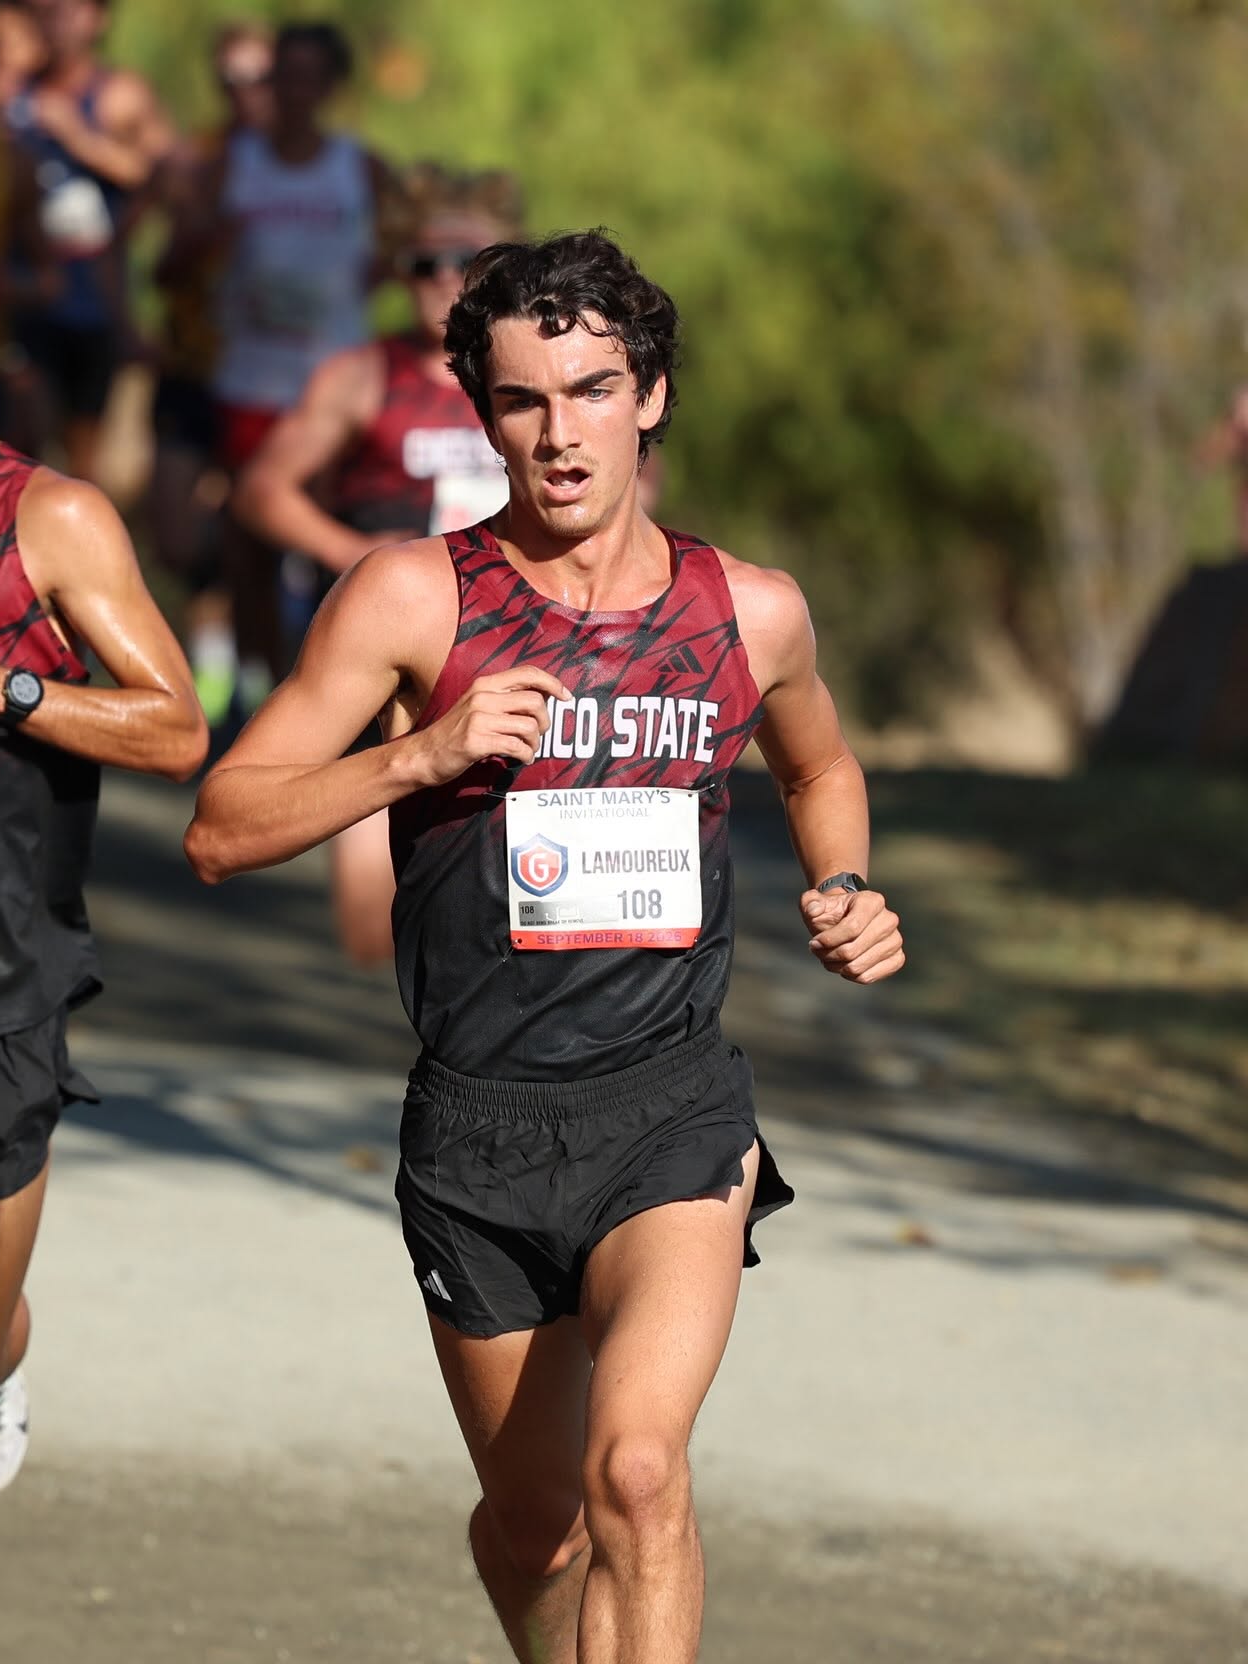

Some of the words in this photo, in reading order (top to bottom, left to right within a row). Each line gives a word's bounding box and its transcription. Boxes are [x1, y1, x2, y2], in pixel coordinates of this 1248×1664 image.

[535, 696, 598, 759] ICO
[611, 696, 719, 763] STATE
[537, 791, 594, 807] SAINT
[601, 789, 671, 805] MARY'S
[559, 807, 649, 820] INVITATIONAL
[528, 853, 550, 883] G
[582, 848, 691, 875] LAMOUREUX
[520, 905, 535, 914] 108
[617, 888, 662, 920] 108
[537, 933, 623, 946] SEPTEMBER
[627, 932, 644, 943] 18
[647, 930, 682, 942] 2026
